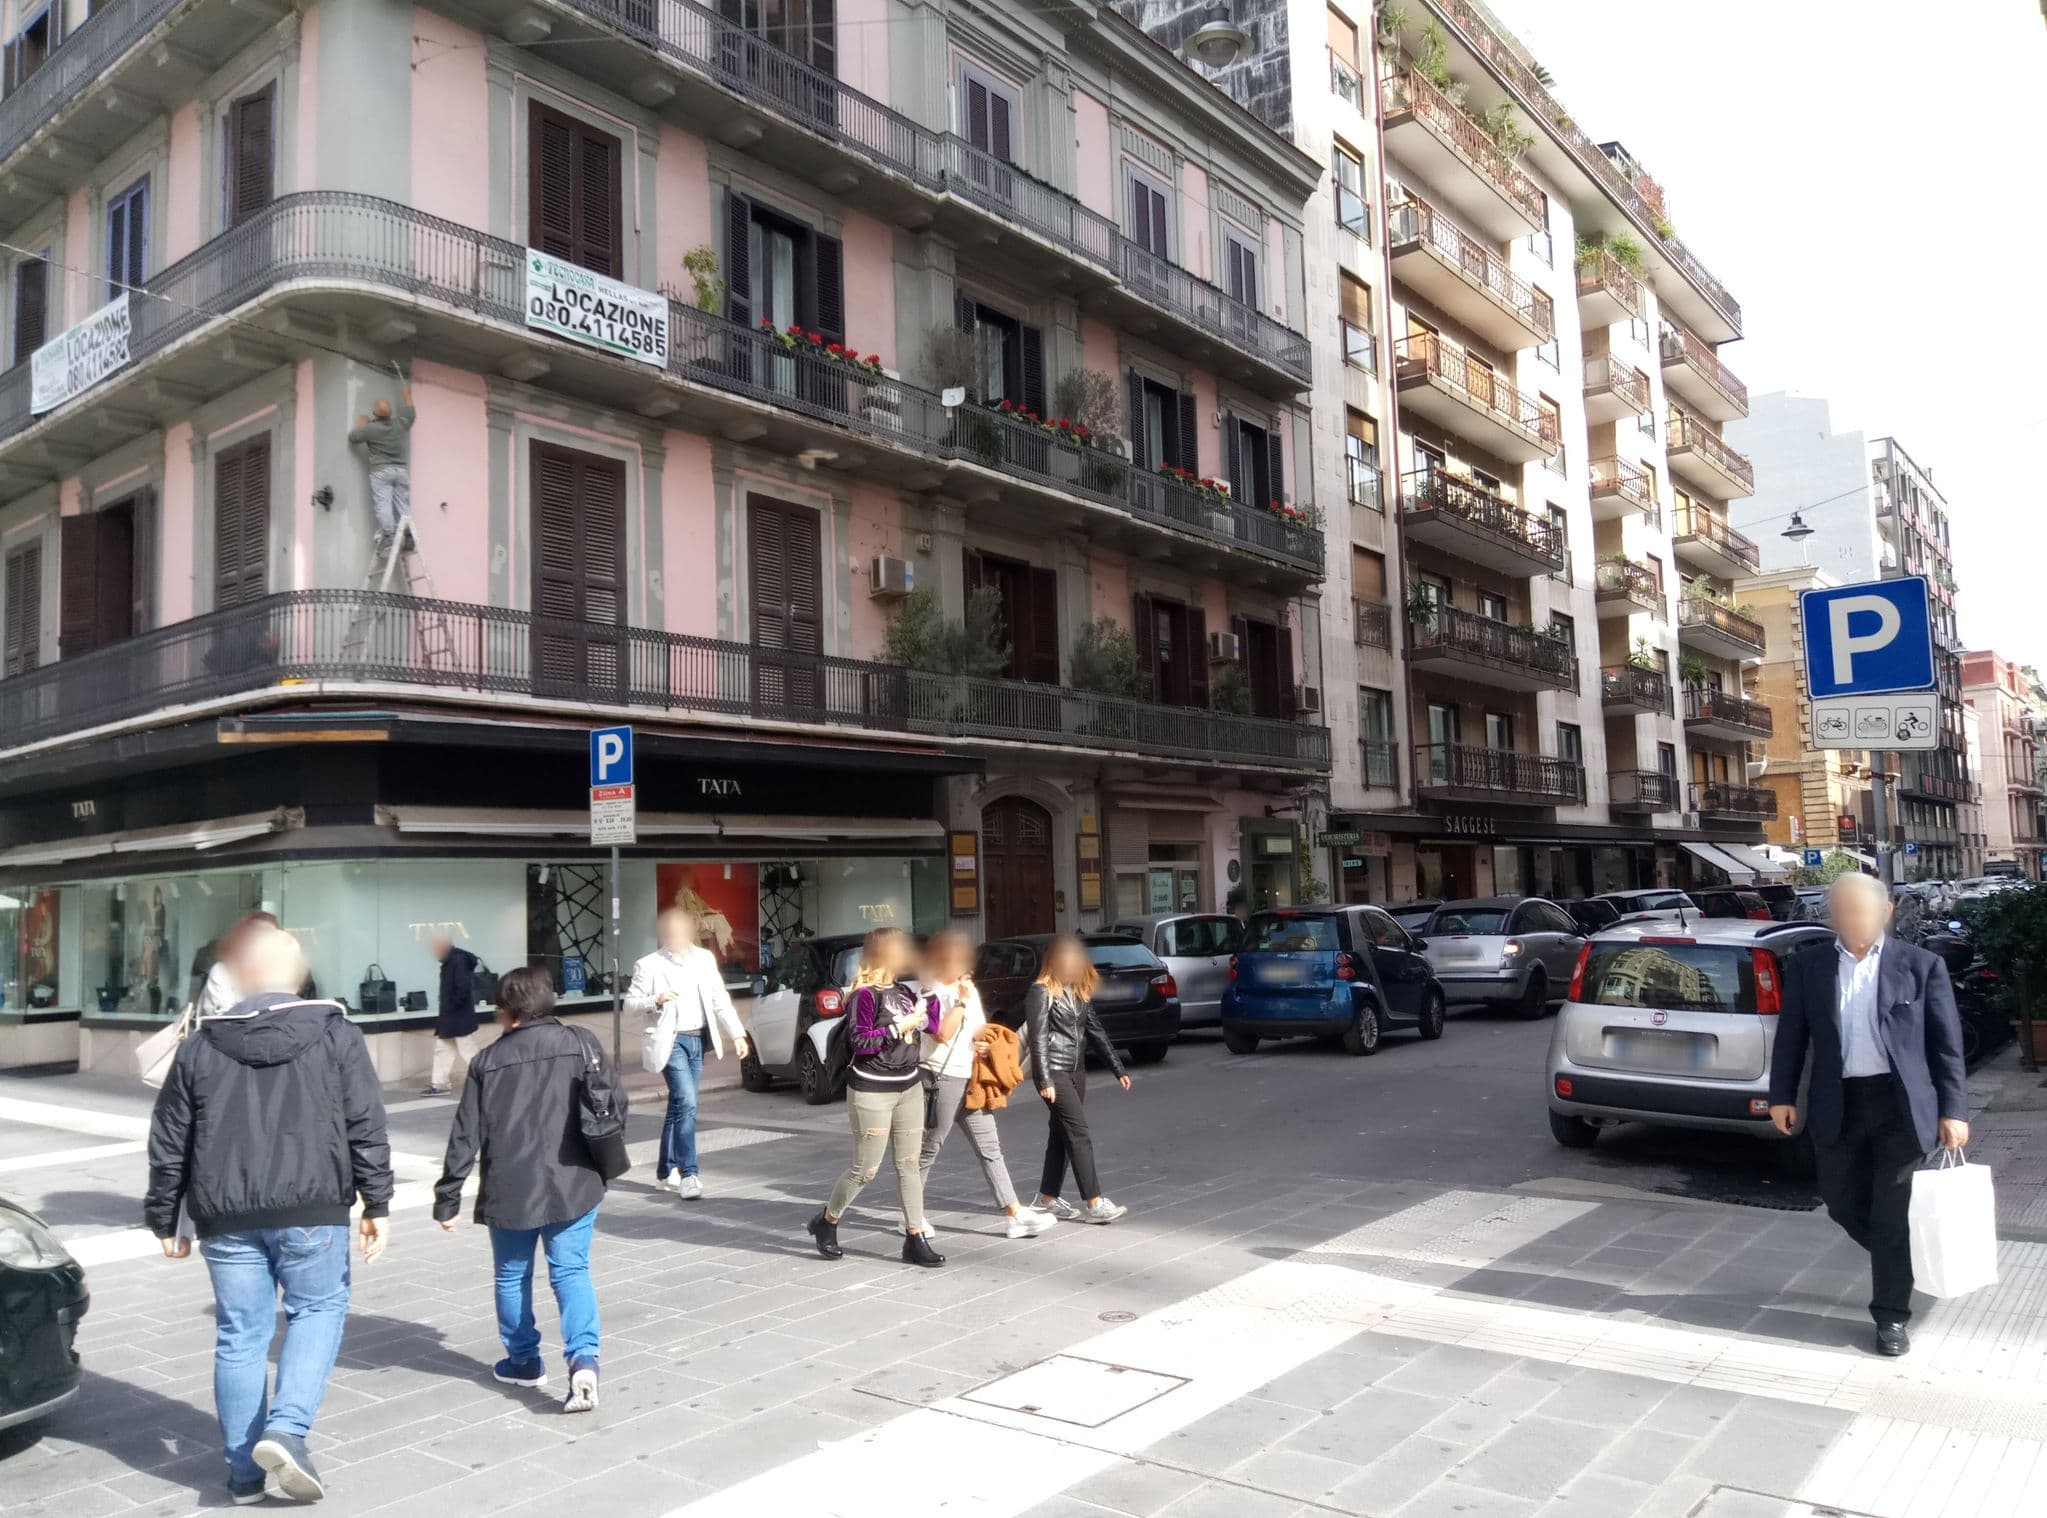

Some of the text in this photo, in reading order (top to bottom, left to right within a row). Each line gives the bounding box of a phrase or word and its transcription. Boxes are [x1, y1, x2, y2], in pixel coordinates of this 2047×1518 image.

[530, 296, 666, 357] 080.4114585
[551, 283, 666, 338] LOCAZIONE
[66, 304, 128, 366] LOCAZIONE
[1828, 594, 1901, 686] P
[598, 733, 624, 780] P
[697, 778, 742, 795] TATA
[71, 800, 96, 818] TATA
[1446, 815, 1496, 834] SAGGESE
[1807, 852, 1818, 865] P
[1906, 843, 1915, 855] P
